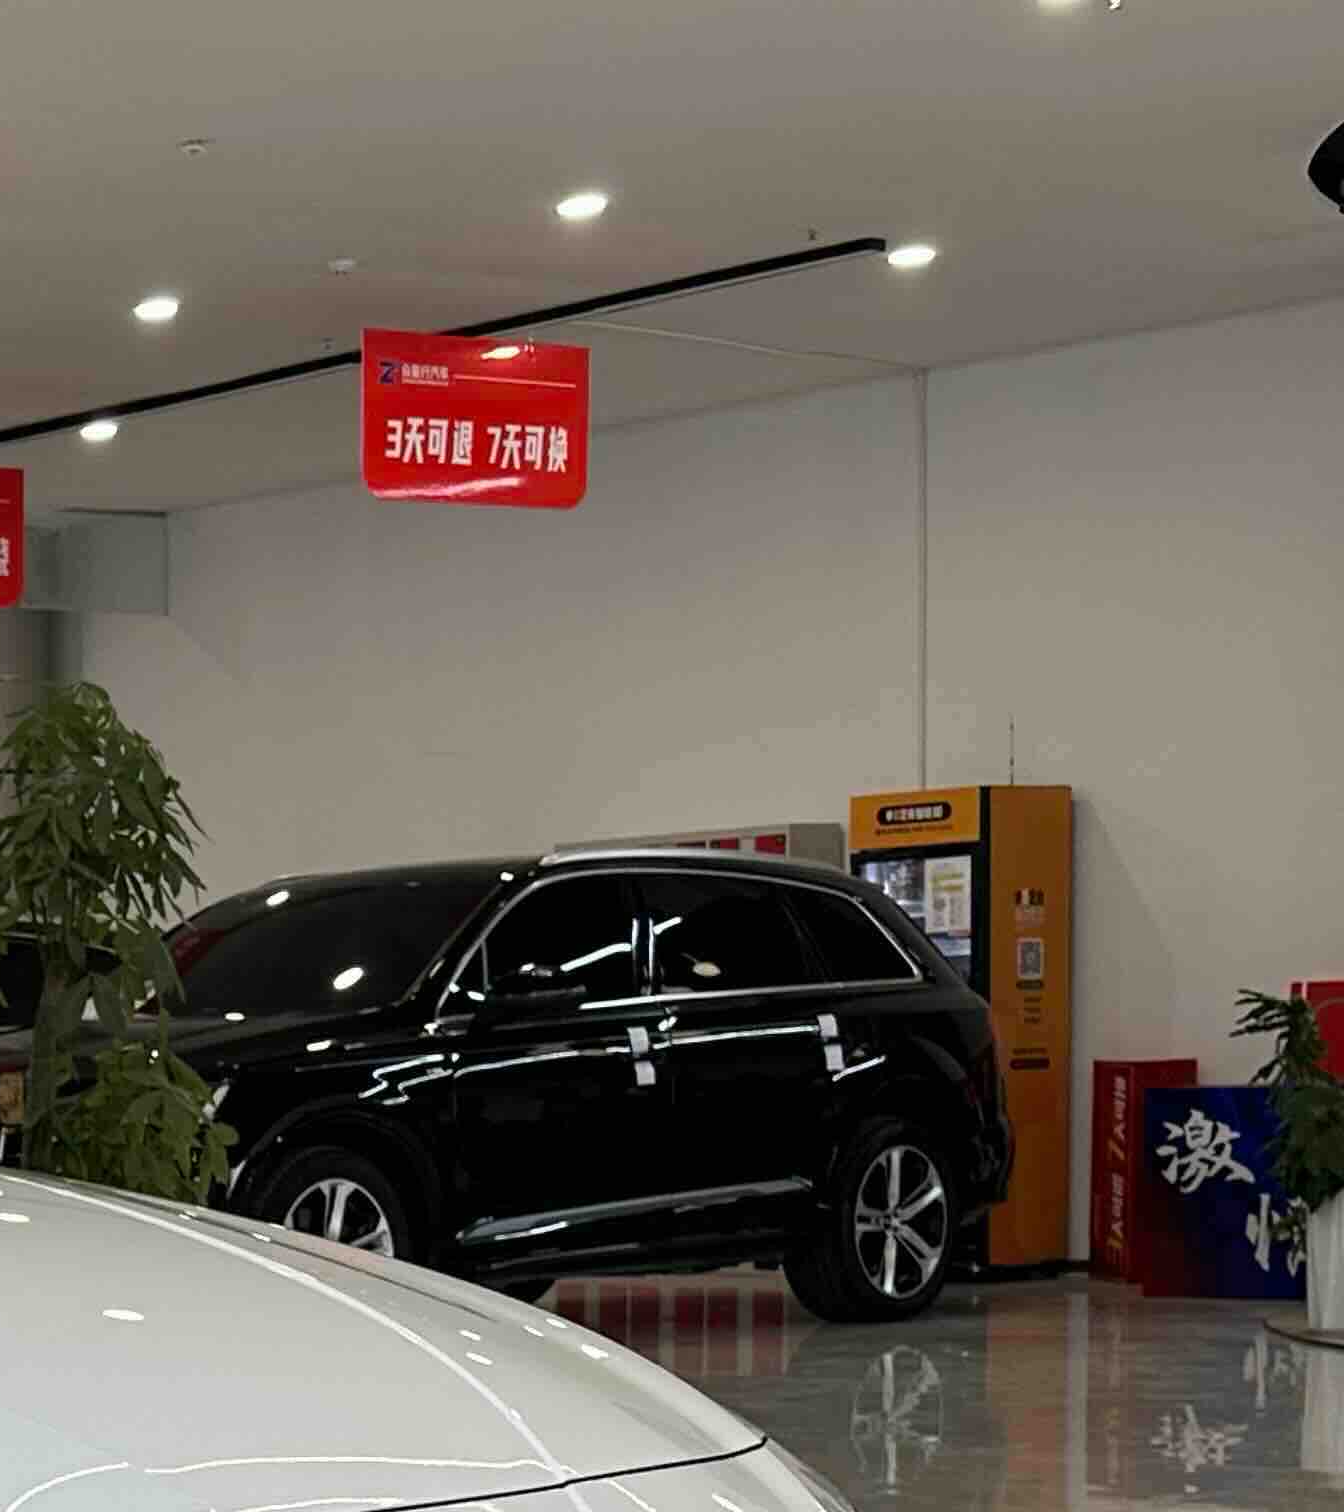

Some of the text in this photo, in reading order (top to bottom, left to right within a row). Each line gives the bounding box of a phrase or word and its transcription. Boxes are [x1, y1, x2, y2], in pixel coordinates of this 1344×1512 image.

[384, 417, 569, 473] 3天可退 7天可换
